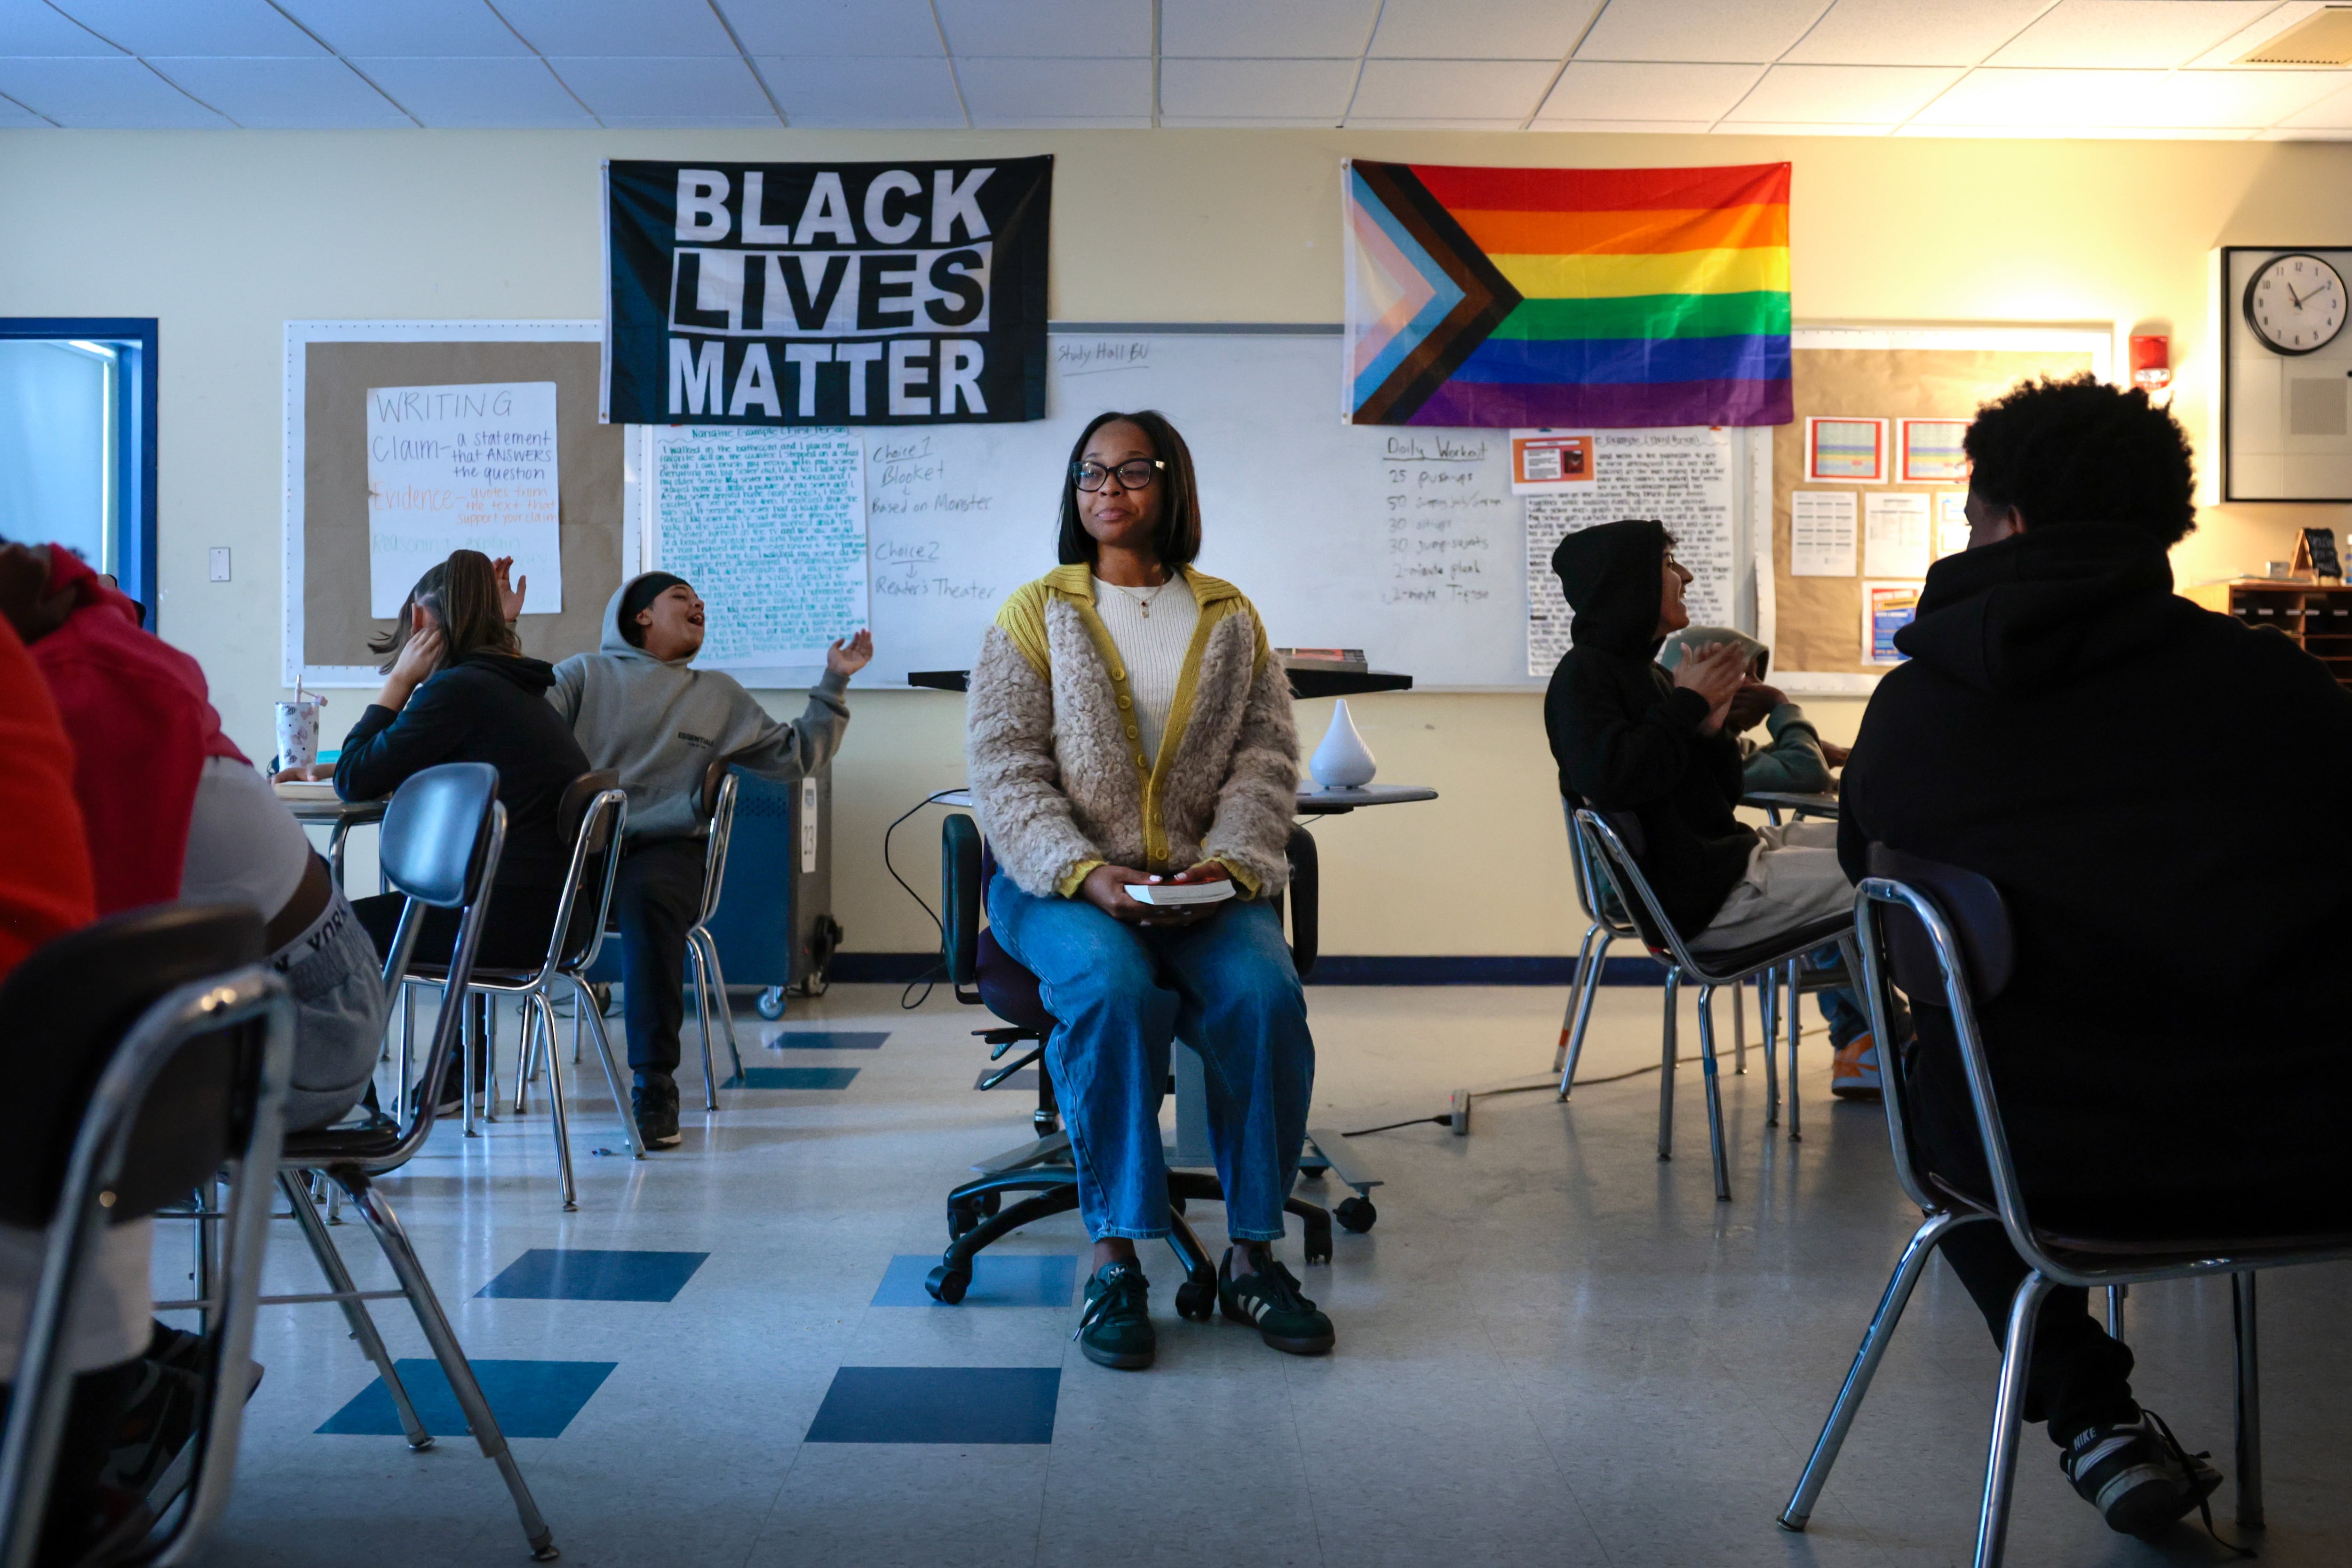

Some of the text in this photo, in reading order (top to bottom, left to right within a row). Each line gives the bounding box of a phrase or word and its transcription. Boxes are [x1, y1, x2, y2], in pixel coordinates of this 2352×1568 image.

[675, 167, 996, 245] BLACK
[2295, 262, 2303, 271] 12
[2315, 267, 2318, 276] 1
[674, 249, 985, 331] LIVES
[2263, 280, 2270, 289] 10
[2332, 299, 2336, 309] 3
[2278, 330, 2281, 339] 7
[2295, 335, 2299, 345] 6
[2314, 331, 2319, 340] 5
[1058, 344, 1090, 367] Study
[1097, 342, 1124, 360] Hall
[668, 339, 988, 417] MATTER
[376, 390, 511, 422] WRITING
[458, 433, 467, 446] a
[474, 430, 551, 447] statement
[452, 449, 550, 462] that ANSWERS
[874, 437, 933, 462] Choice 1
[1388, 436, 1488, 459] Daily Workout
[453, 467, 544, 486] the question
[881, 461, 944, 487] Blooket
[1390, 470, 1407, 483] 25
[471, 487, 509, 500] quotes
[515, 486, 548, 498] from
[465, 500, 555, 511] the text that
[872, 494, 993, 514] Based on Monster
[1388, 494, 1407, 510] 50
[457, 511, 556, 527] support your claim
[875, 542, 940, 560] Choice 2
[932, 579, 996, 599] Theater
[804, 825, 813, 855] 23
[2074, 1427, 2096, 1451] NIKE
